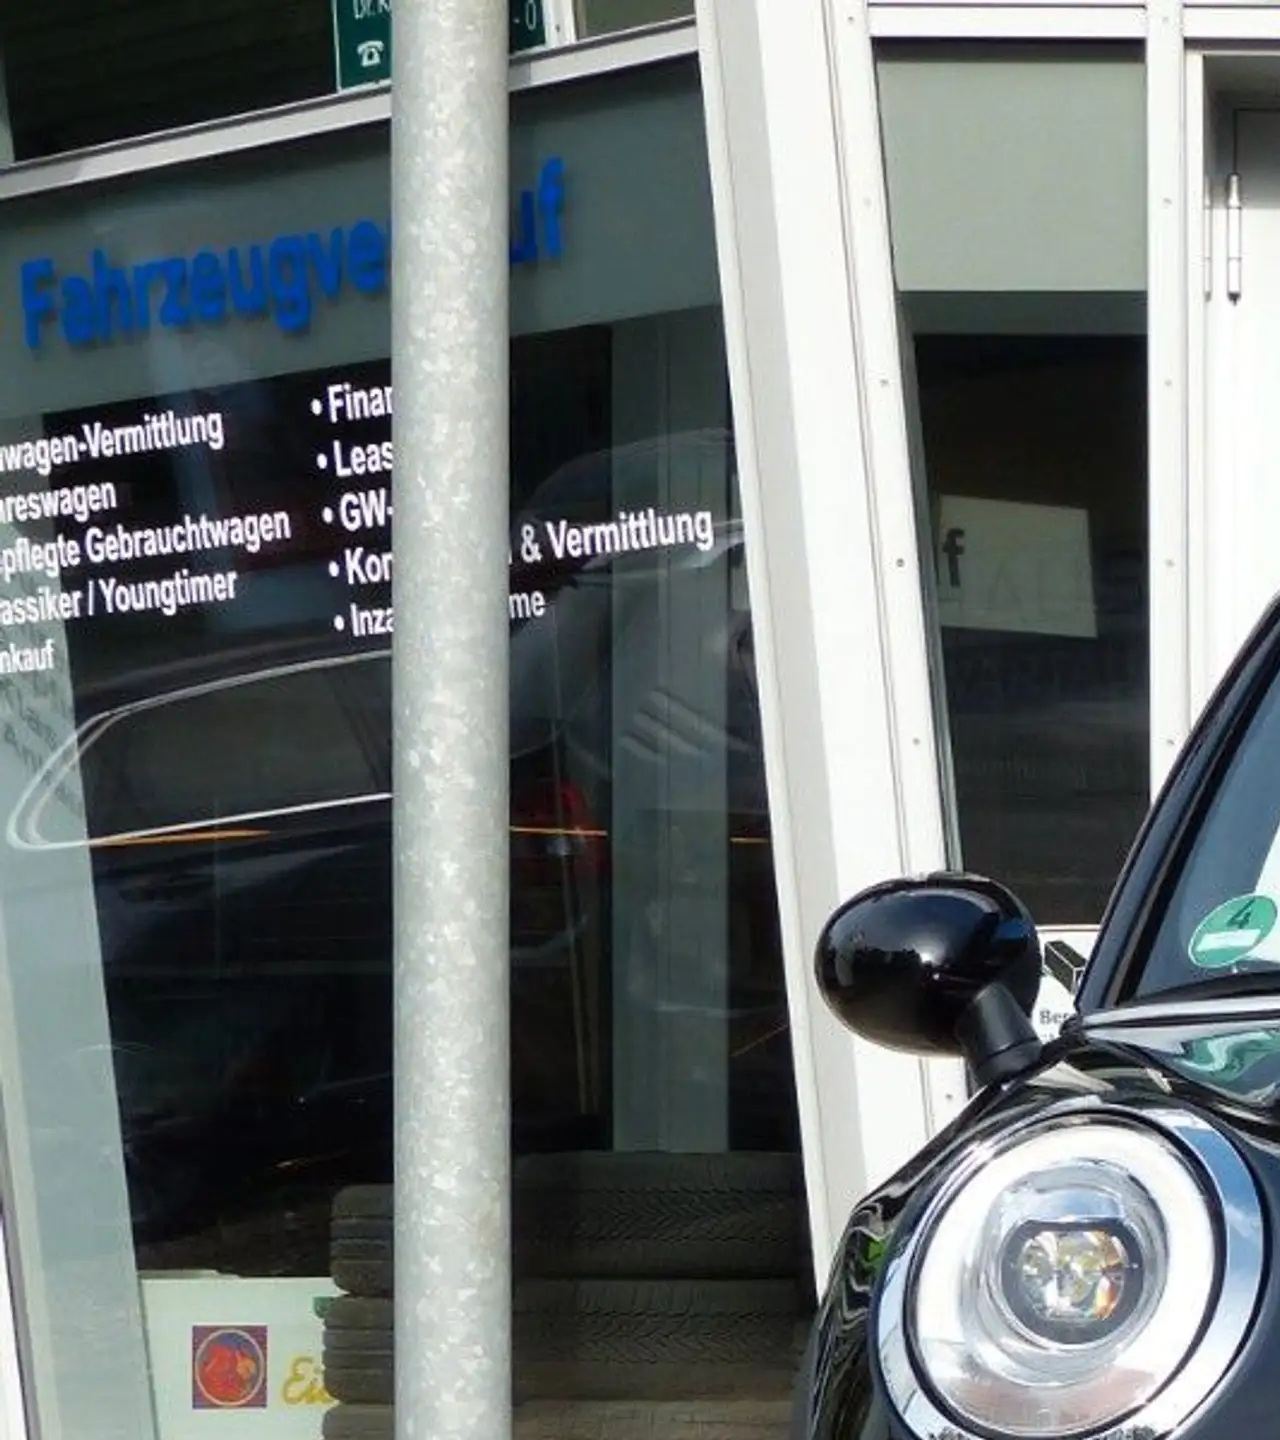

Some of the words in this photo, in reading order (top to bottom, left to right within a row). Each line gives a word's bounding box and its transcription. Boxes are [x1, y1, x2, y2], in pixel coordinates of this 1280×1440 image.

[0, 410, 224, 475] wagen-Vermittlung
[333, 440, 393, 476] Leas
[340, 488, 393, 531] GW-
[520, 524, 542, 562] &
[546, 507, 714, 559] Vermittlung
[0, 534, 81, 582] pflegte
[84, 511, 292, 553] Gebrauchtwagen
[0, 583, 83, 626] assiker
[98, 569, 238, 616] Youngtimer
[1226, 898, 1255, 929] 4
